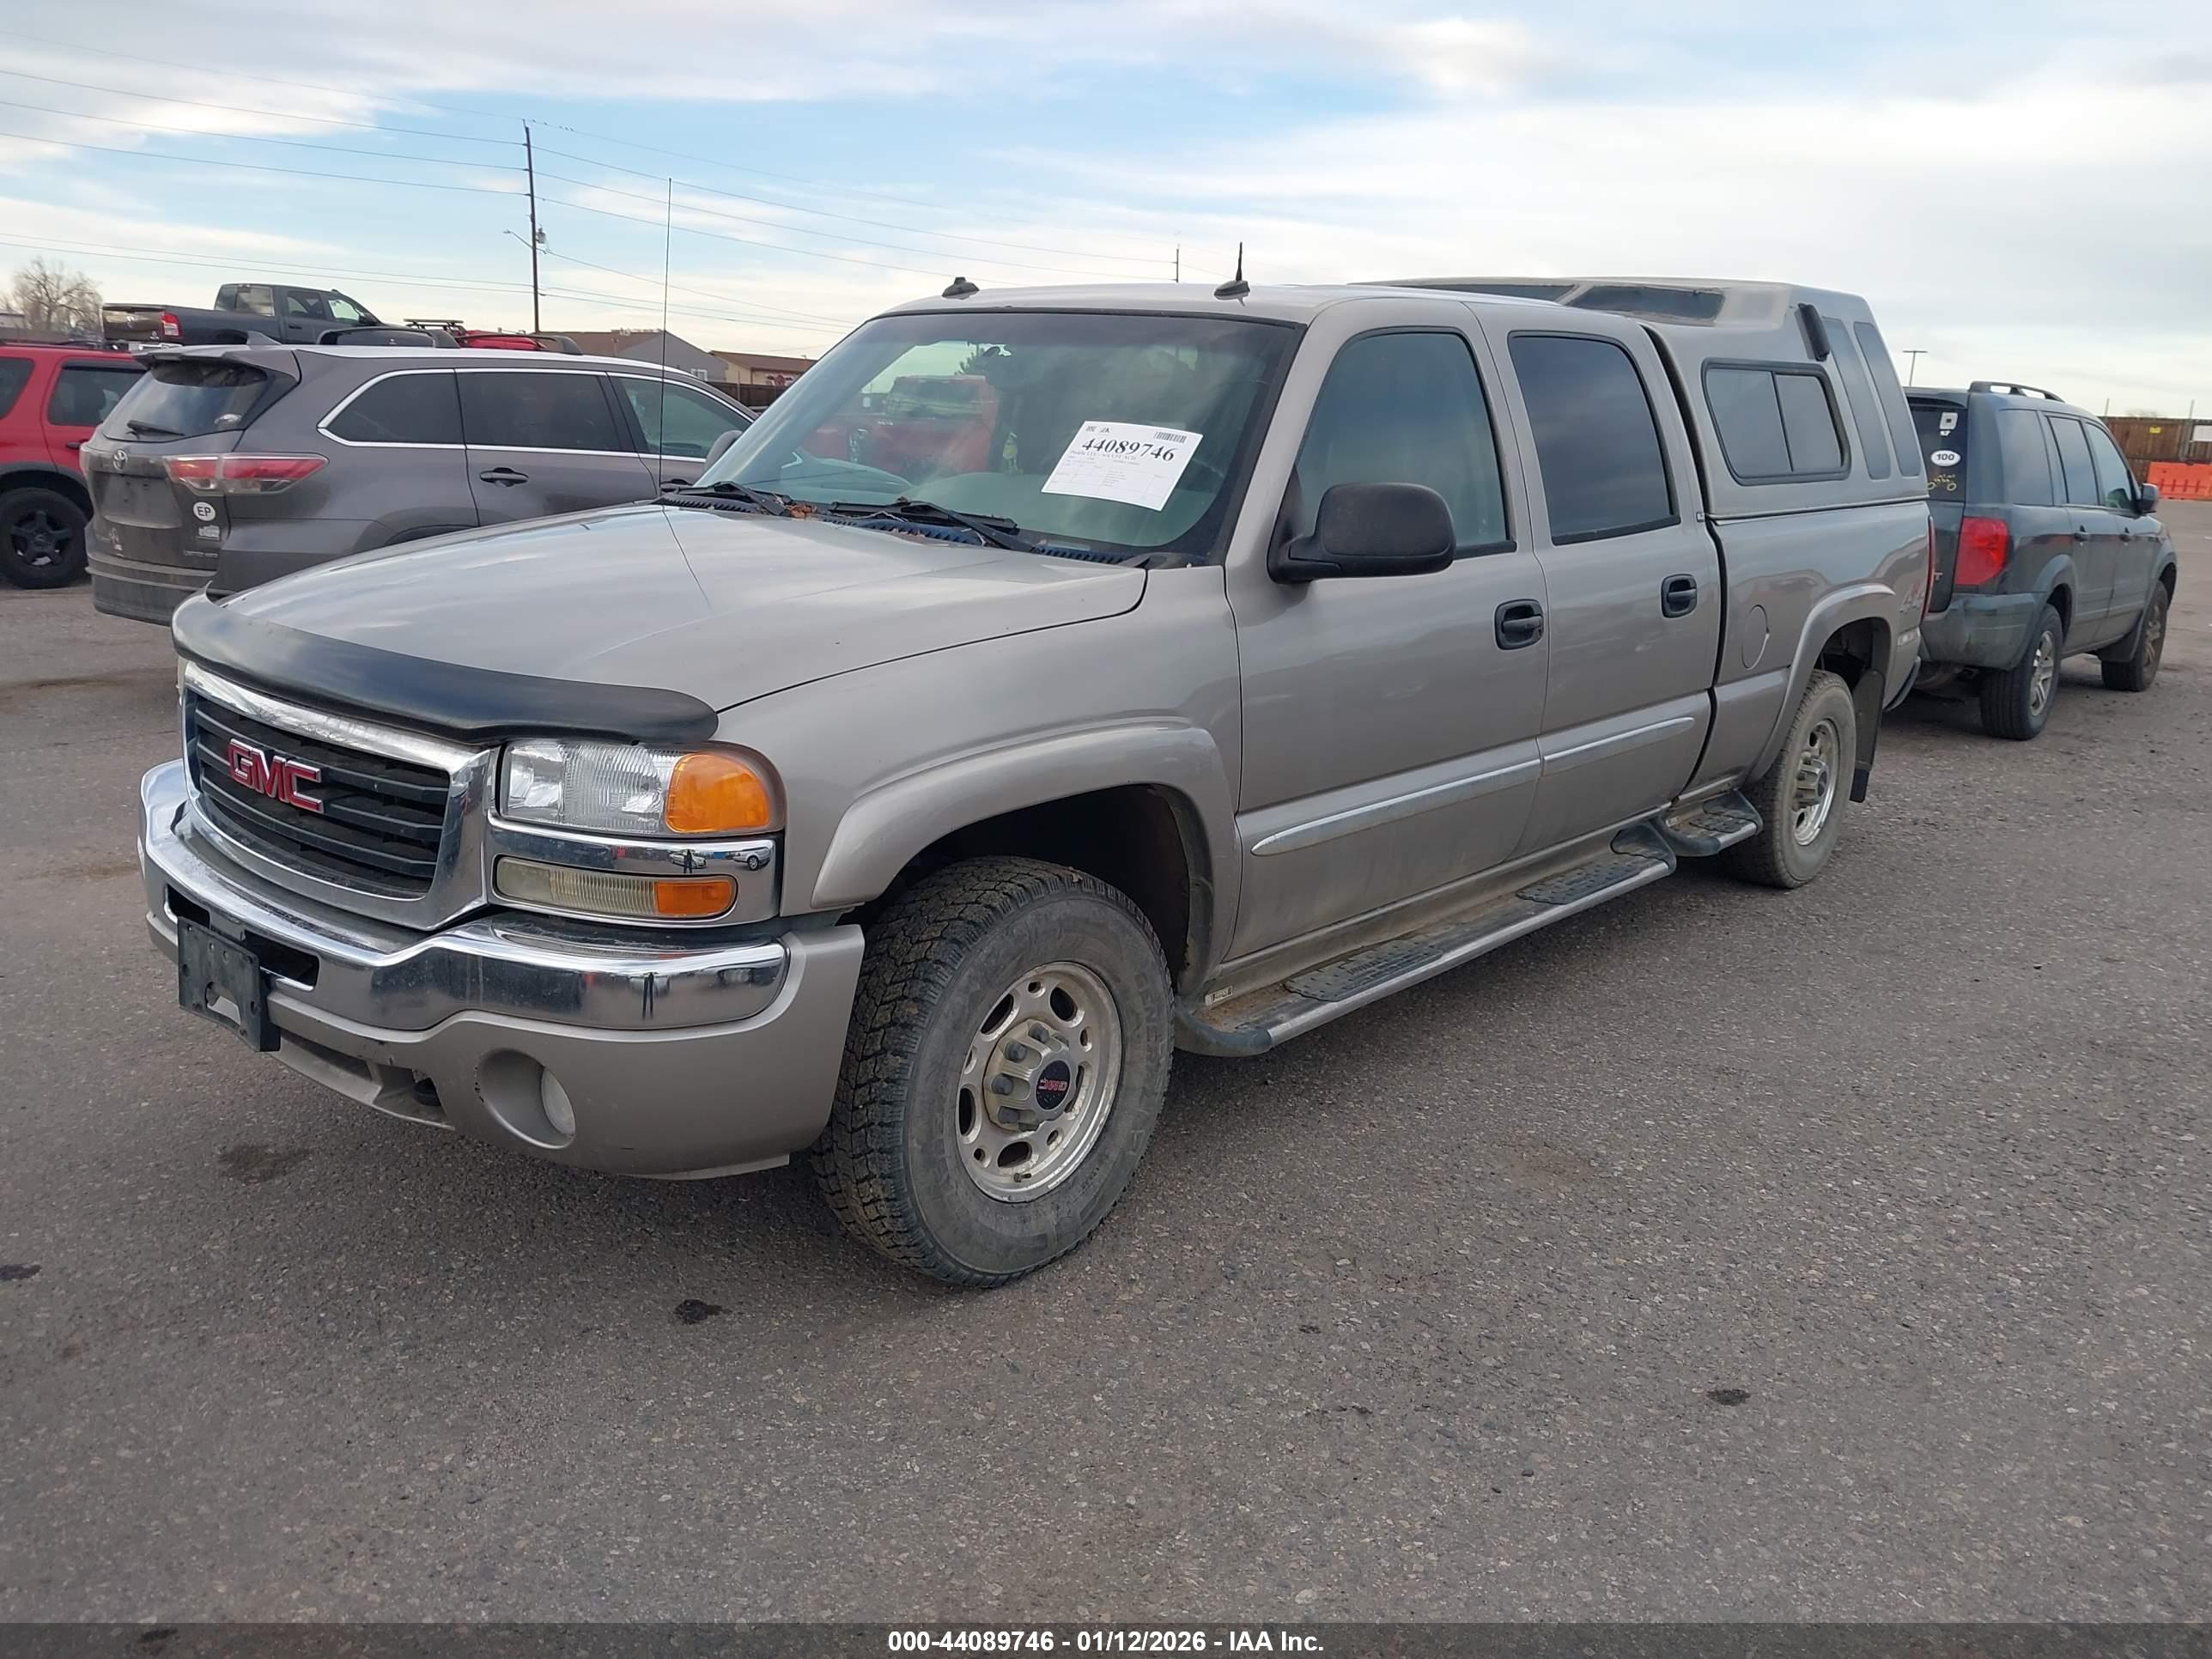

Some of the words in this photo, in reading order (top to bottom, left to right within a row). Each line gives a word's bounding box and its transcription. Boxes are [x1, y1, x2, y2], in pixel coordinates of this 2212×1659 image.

[1082, 438, 1179, 461] 44089746
[197, 506, 211, 517] EP
[227, 738, 325, 814] GMC
[1038, 1078, 1067, 1091] GMC
